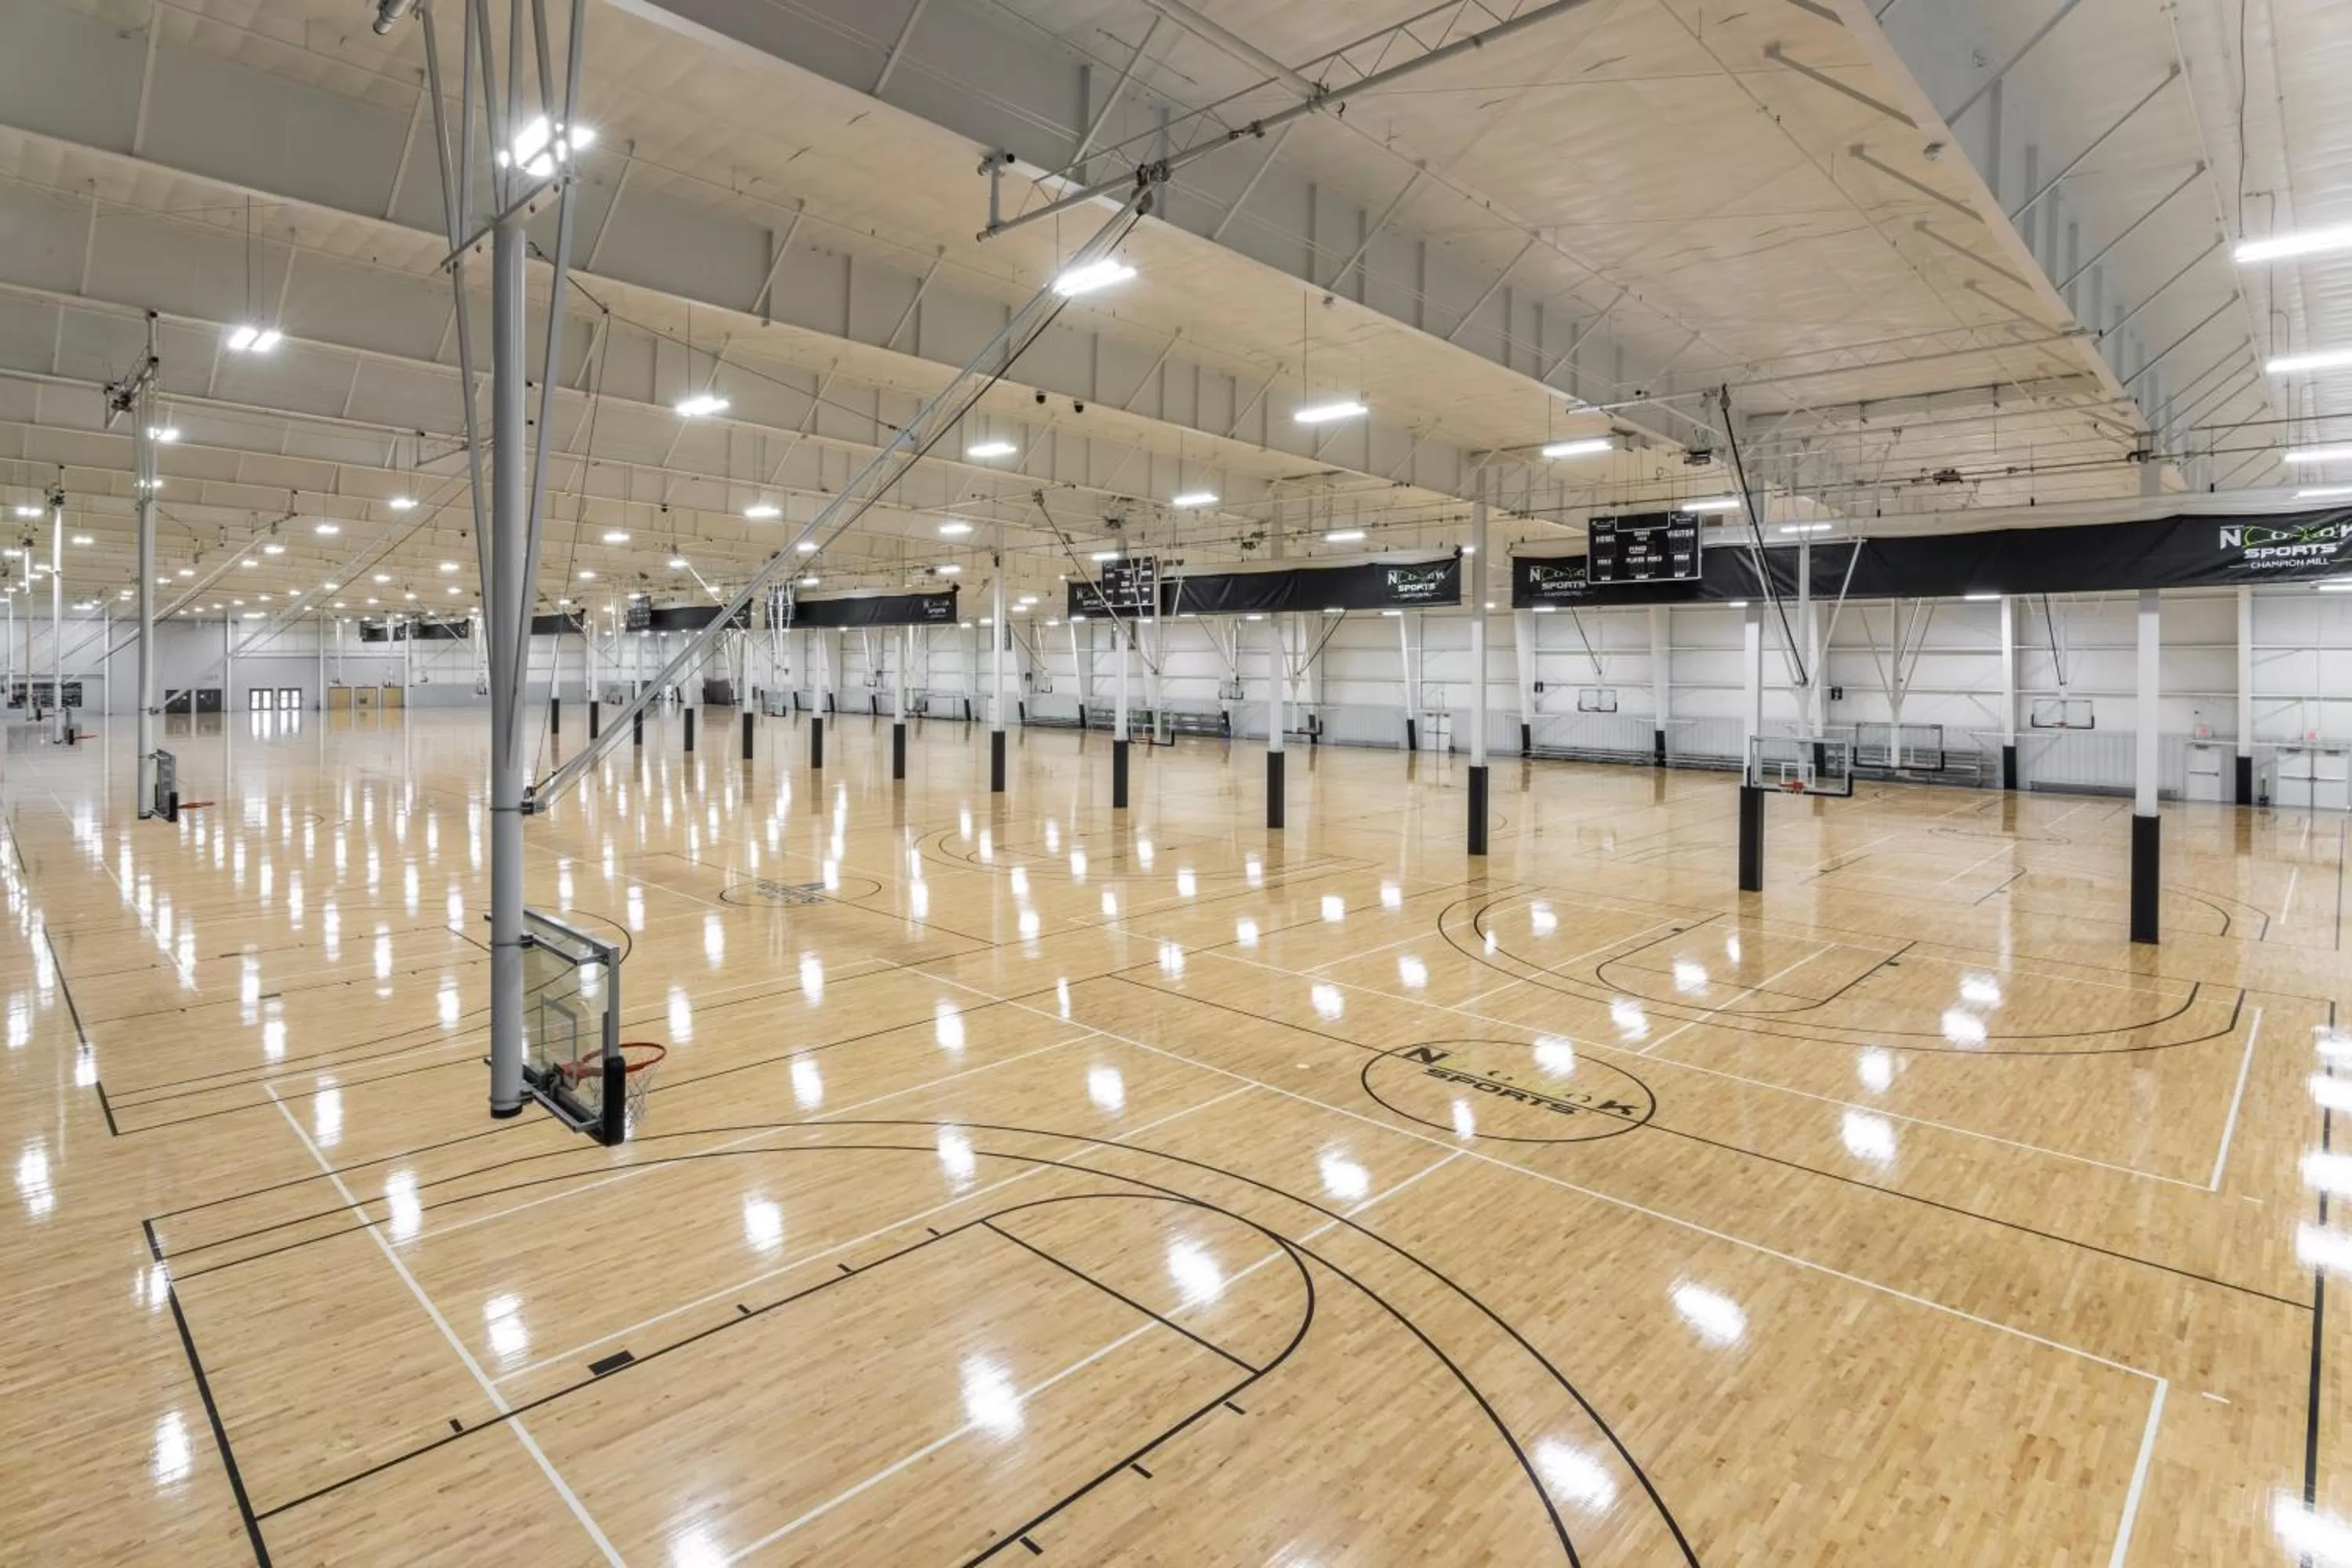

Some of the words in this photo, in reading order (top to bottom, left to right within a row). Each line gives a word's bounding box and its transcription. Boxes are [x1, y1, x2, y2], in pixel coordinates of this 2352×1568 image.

[2244, 543, 2337, 559] SPORTS
[2250, 559, 2305, 569] CHAMPION
[1398, 583, 1436, 593] SPORTS
[1541, 580, 1587, 590] SPORTS
[1423, 1068, 1580, 1116] SPORTS
